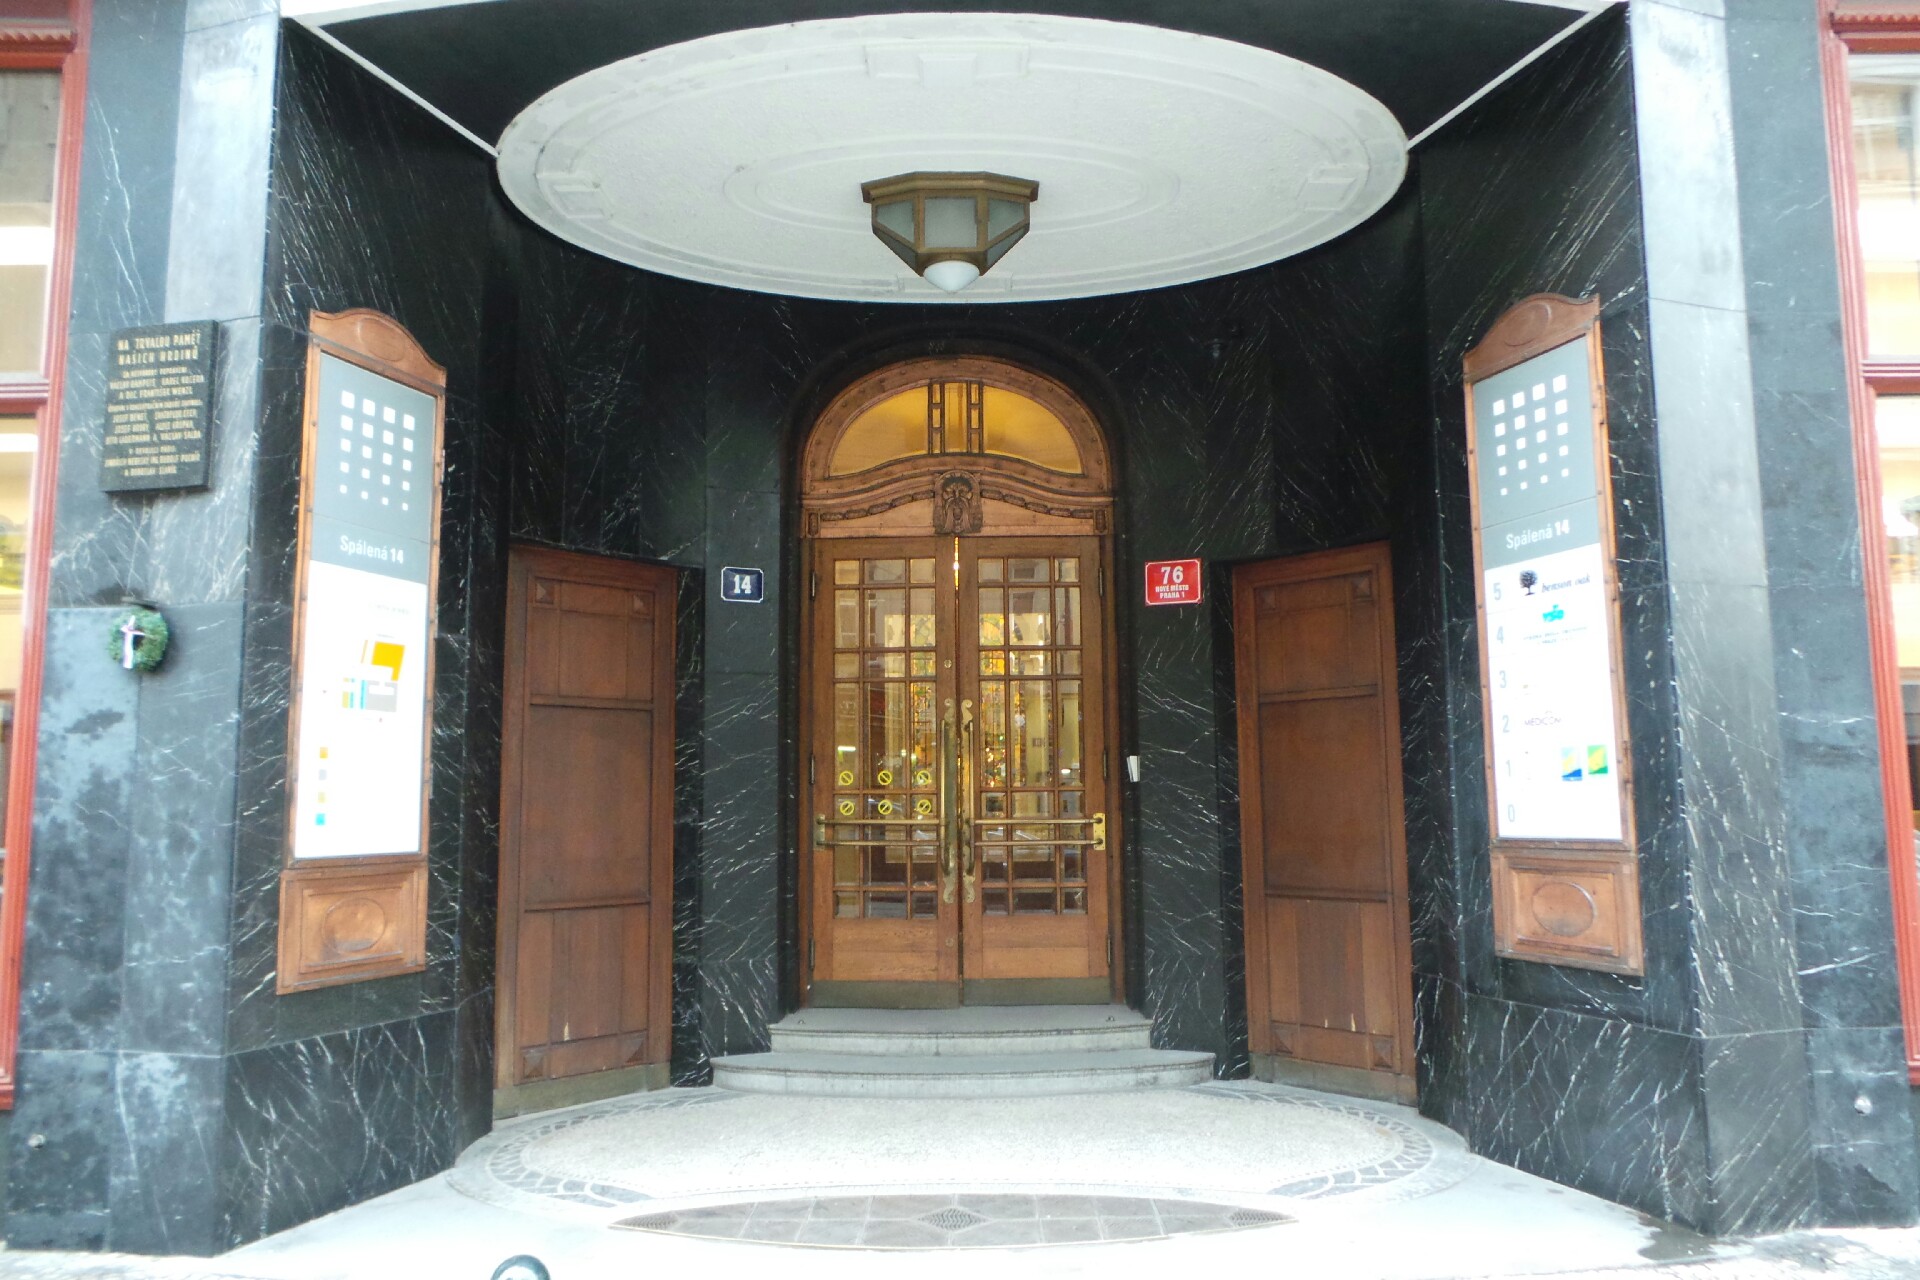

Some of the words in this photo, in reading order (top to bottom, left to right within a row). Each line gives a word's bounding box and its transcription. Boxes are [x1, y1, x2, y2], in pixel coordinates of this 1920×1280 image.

[117, 339, 129, 351] NA
[118, 350, 155, 366] NAŠICH
[1505, 523, 1552, 550] Spálená
[1555, 519, 1570, 536] 14
[340, 535, 388, 560] Spálená
[390, 548, 404, 564] 14
[733, 574, 752, 594] 14
[1161, 565, 1184, 585] 76
[1160, 591, 1180, 599] PRAHA
[1493, 582, 1502, 601] 5
[1496, 626, 1505, 644] 4
[1499, 670, 1507, 688] 3
[1502, 715, 1510, 733] 2
[1506, 759, 1511, 777] 1
[1507, 803, 1516, 822] 0
